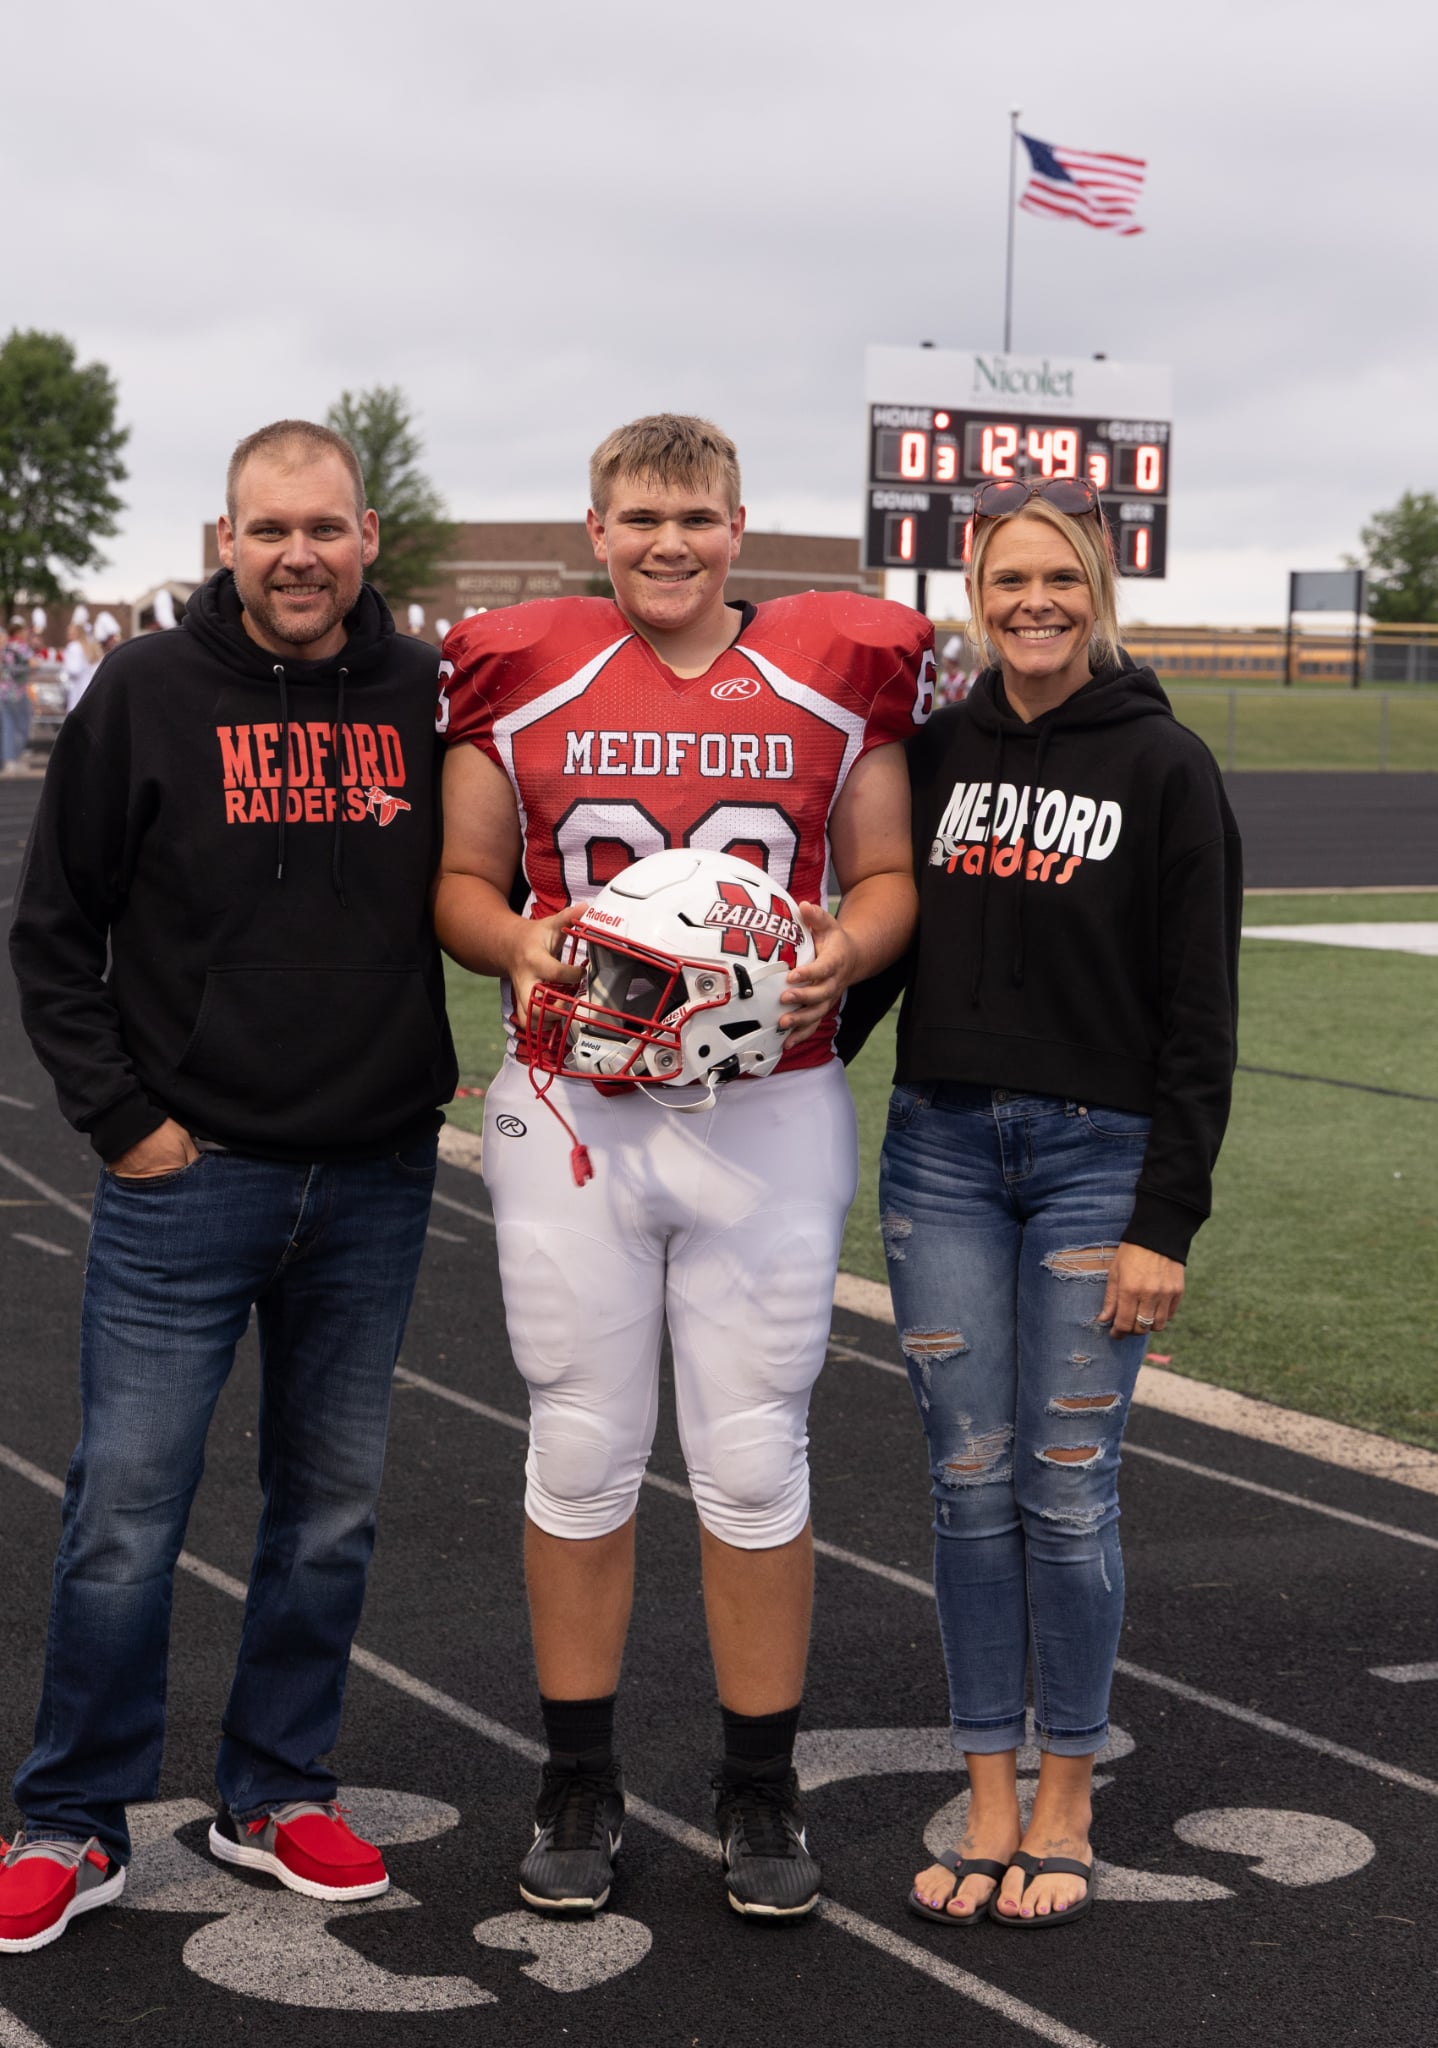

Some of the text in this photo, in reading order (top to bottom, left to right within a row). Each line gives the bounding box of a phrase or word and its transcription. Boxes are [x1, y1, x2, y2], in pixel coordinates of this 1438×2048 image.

[973, 355, 1074, 398] Nicolet
[873, 407, 934, 429] HOME
[1108, 420, 1168, 443] GUEST
[900, 431, 926, 479] 0
[936, 445, 956, 480] 3
[982, 425, 1078, 478] 12:49
[1088, 453, 1108, 490] 3
[1136, 445, 1161, 491] 0
[872, 491, 930, 511] DOWN
[900, 516, 913, 561] 1
[1135, 527, 1149, 571] 1
[216, 722, 407, 788] MEDFORD
[562, 730, 795, 780] MEDFORD
[224, 787, 367, 823] RAIDERS
[936, 781, 1123, 861] MEDFORD
[946, 834, 1082, 885] raiders
[586, 907, 622, 928] Riddell
[705, 901, 799, 943] RAIDERS
